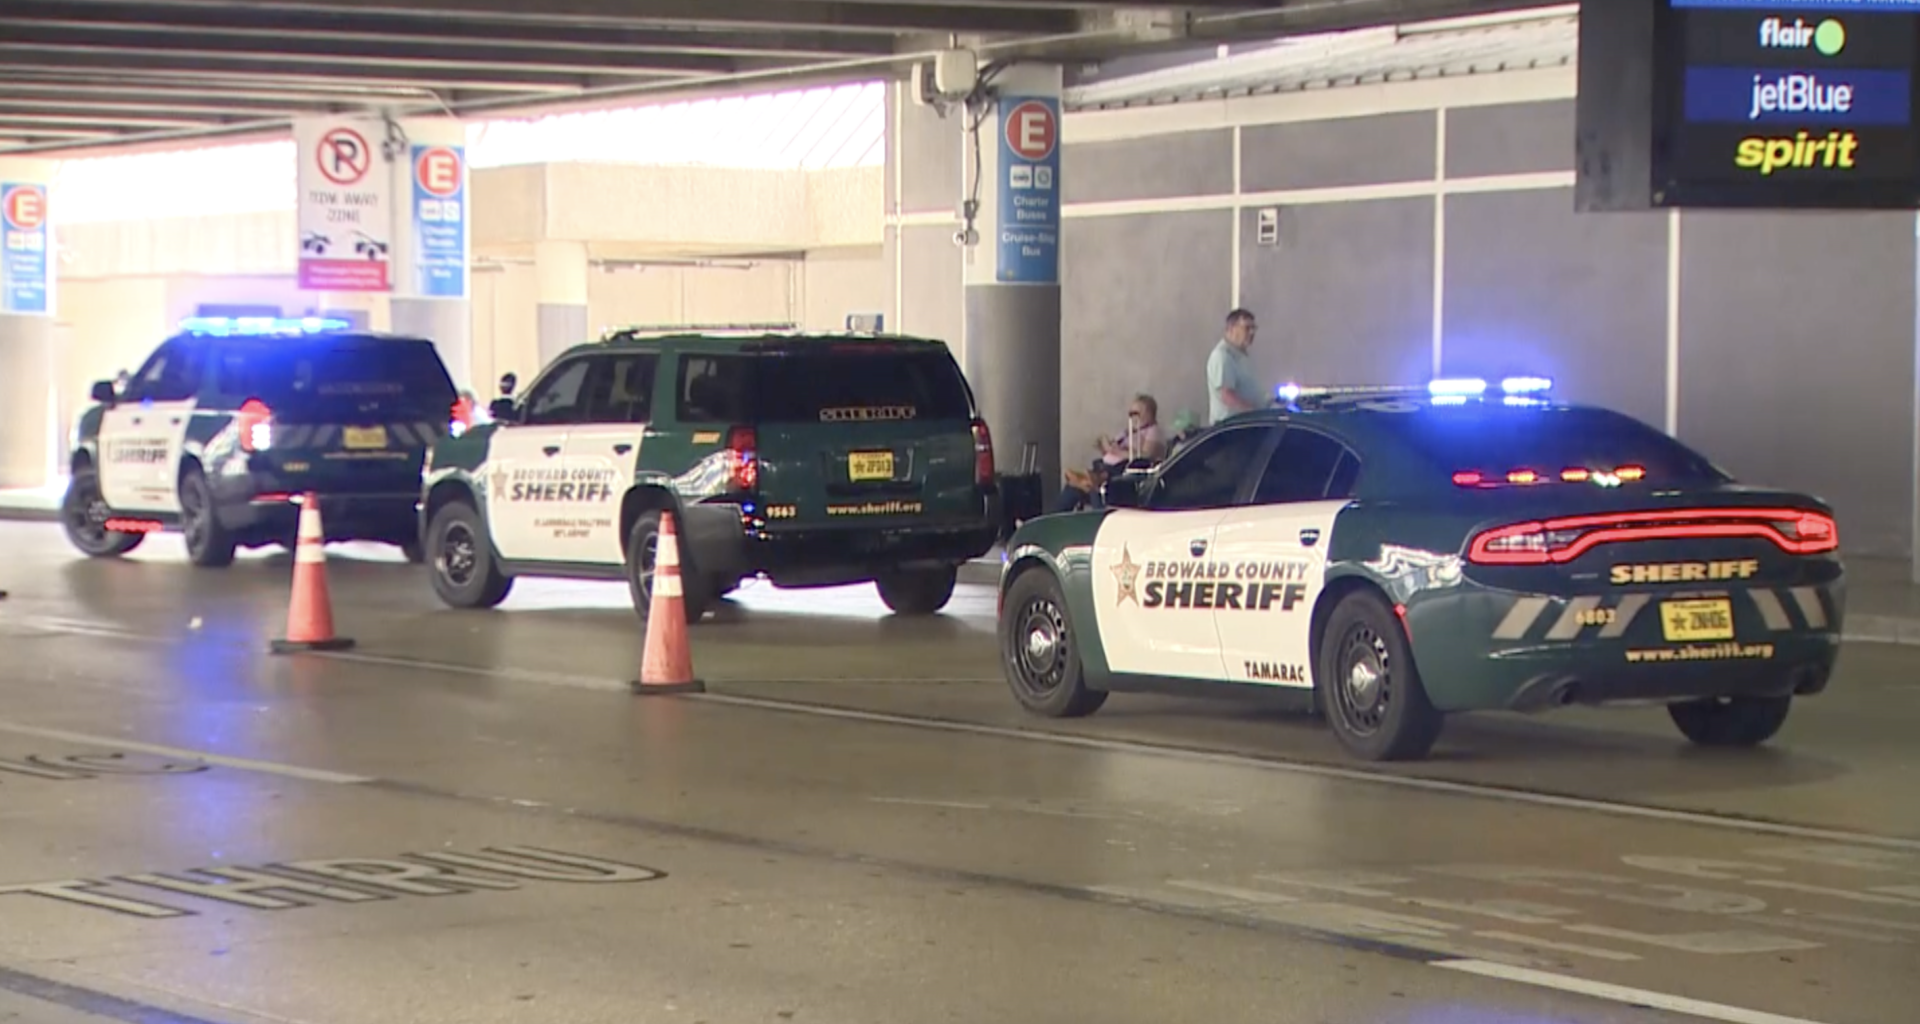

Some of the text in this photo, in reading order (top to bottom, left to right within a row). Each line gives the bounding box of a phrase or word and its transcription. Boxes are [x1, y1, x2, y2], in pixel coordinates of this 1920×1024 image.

[1759, 18, 1813, 47] flair
[1749, 75, 1851, 119] jetBlue
[1020, 111, 1047, 150] E
[1734, 131, 1858, 174] spirit
[427, 155, 454, 189] E
[16, 194, 38, 223] E
[513, 469, 616, 481] BROWARD COUNTY
[511, 482, 614, 502] SHERIFF
[766, 505, 796, 518] 9563
[827, 501, 922, 516] www.sheriff.org
[1145, 561, 1309, 581] BROWARD COUNTY
[1609, 559, 1759, 584] SHERIFF
[1143, 581, 1307, 611] SHERIFF
[1625, 643, 1775, 662] www.sheriff.org
[1244, 661, 1305, 683] TAMARAC
[0, 844, 668, 919] THRU
